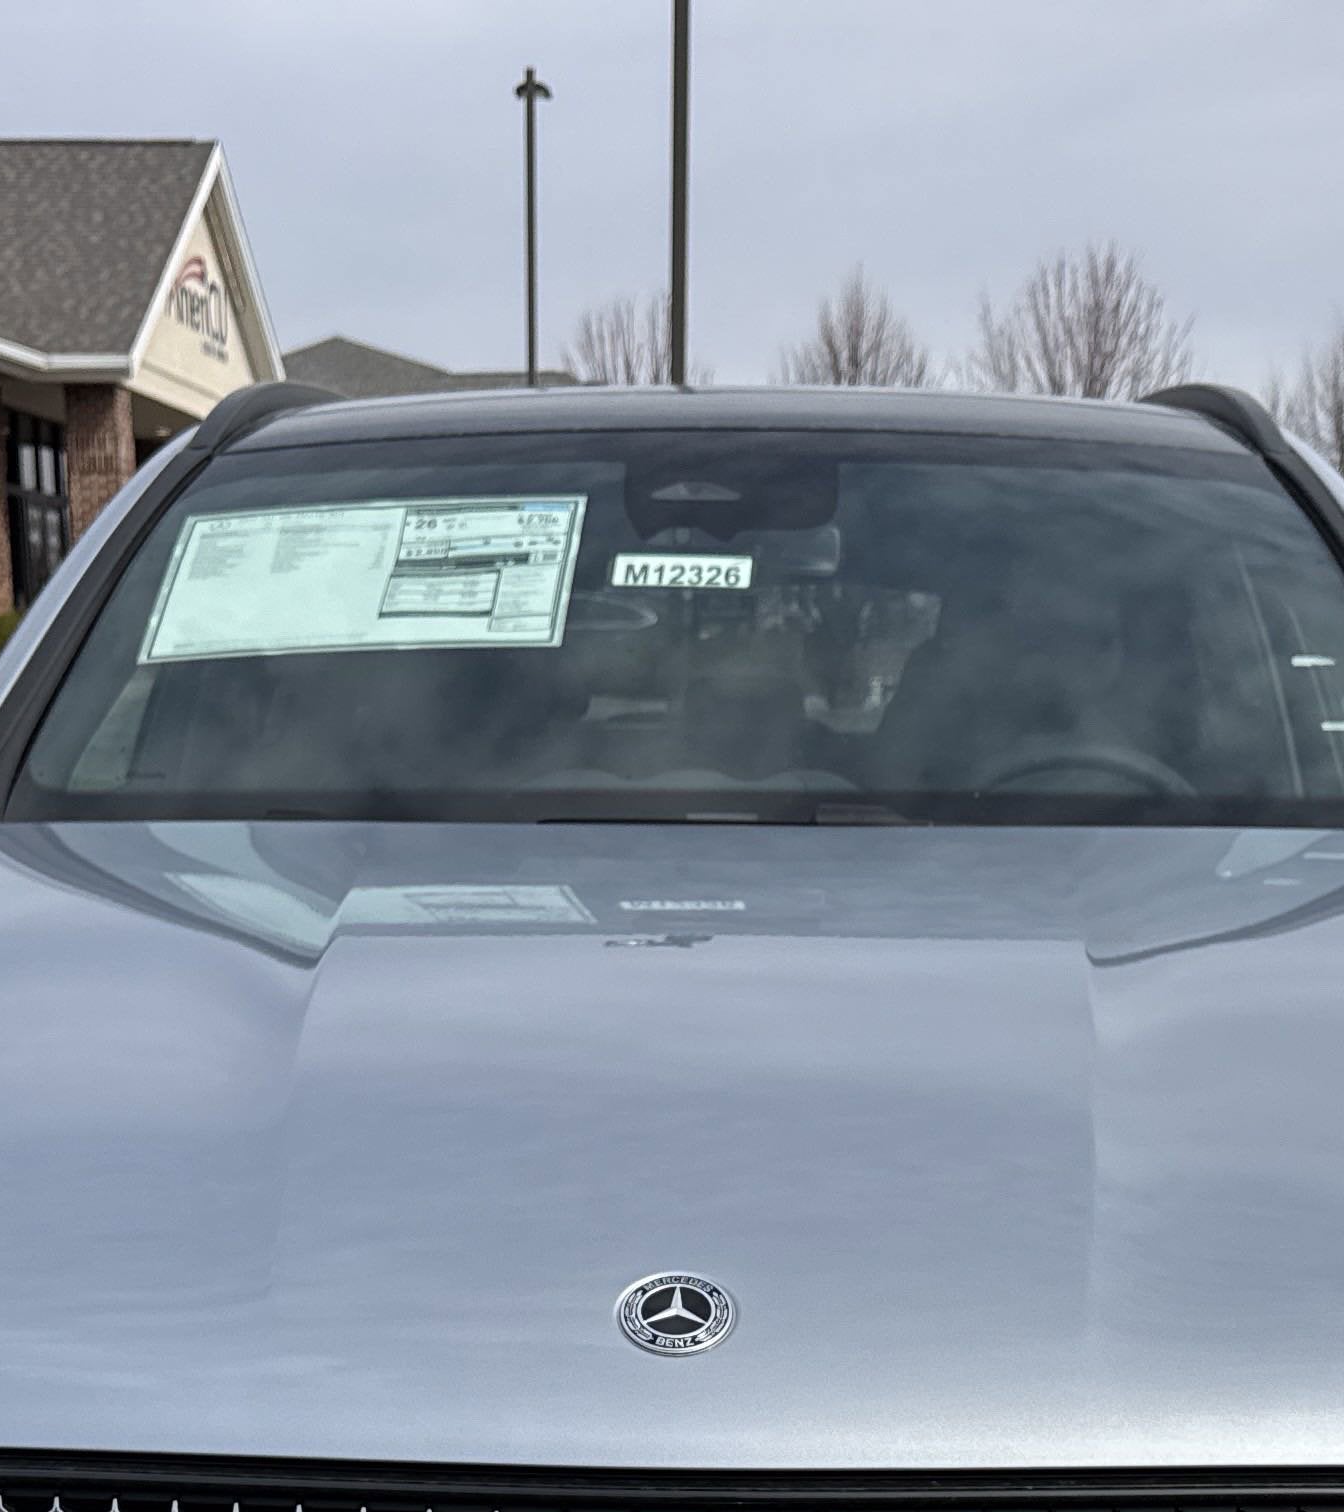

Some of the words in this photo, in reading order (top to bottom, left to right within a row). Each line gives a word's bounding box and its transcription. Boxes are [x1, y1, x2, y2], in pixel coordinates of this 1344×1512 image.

[624, 563, 741, 587] M12326
[643, 1275, 714, 1293] MERCEDES
[655, 1336, 695, 1348] BENZ
